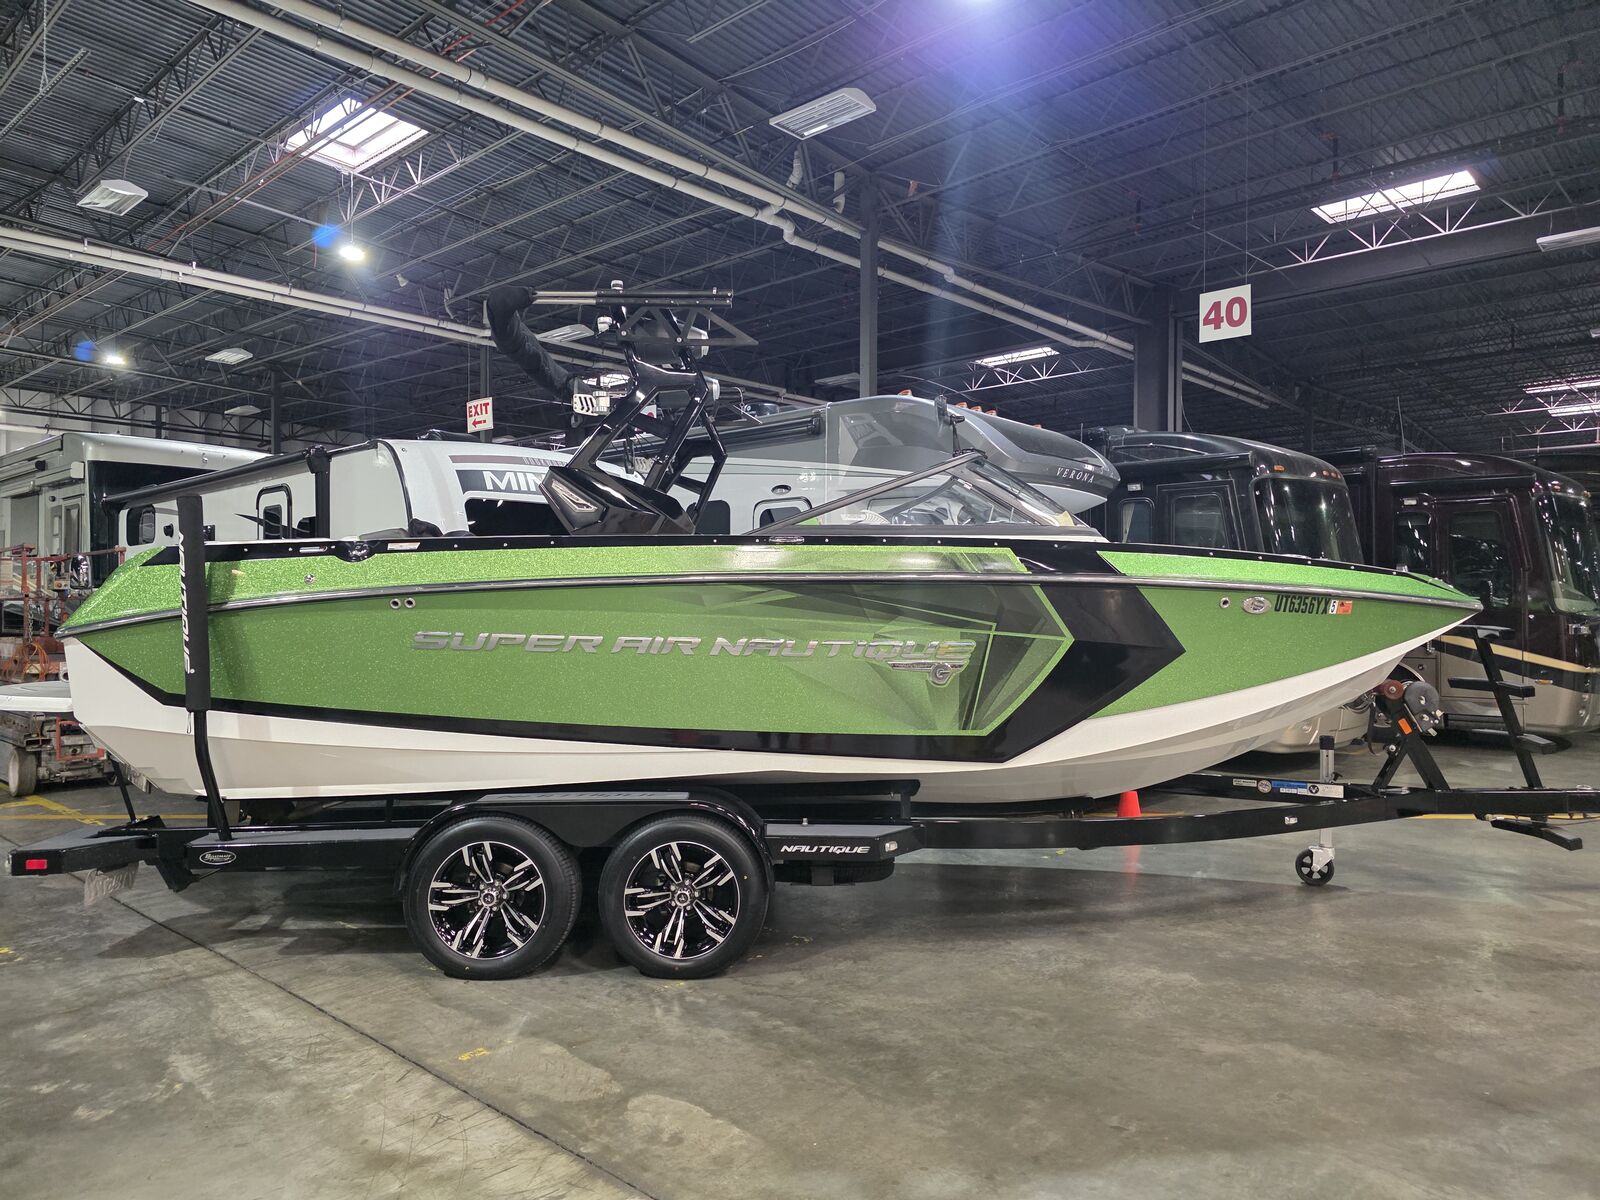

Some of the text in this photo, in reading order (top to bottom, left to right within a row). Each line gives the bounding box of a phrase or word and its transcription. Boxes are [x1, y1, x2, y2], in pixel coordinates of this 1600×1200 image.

[1202, 296, 1248, 331] 40
[468, 402, 490, 418] EXIT
[1056, 467, 1095, 484] VERONA
[1274, 594, 1330, 615] UT6356YX
[414, 631, 977, 661] SUPER AIR NAUTIQUE
[780, 845, 871, 855] NAUTIQUE
